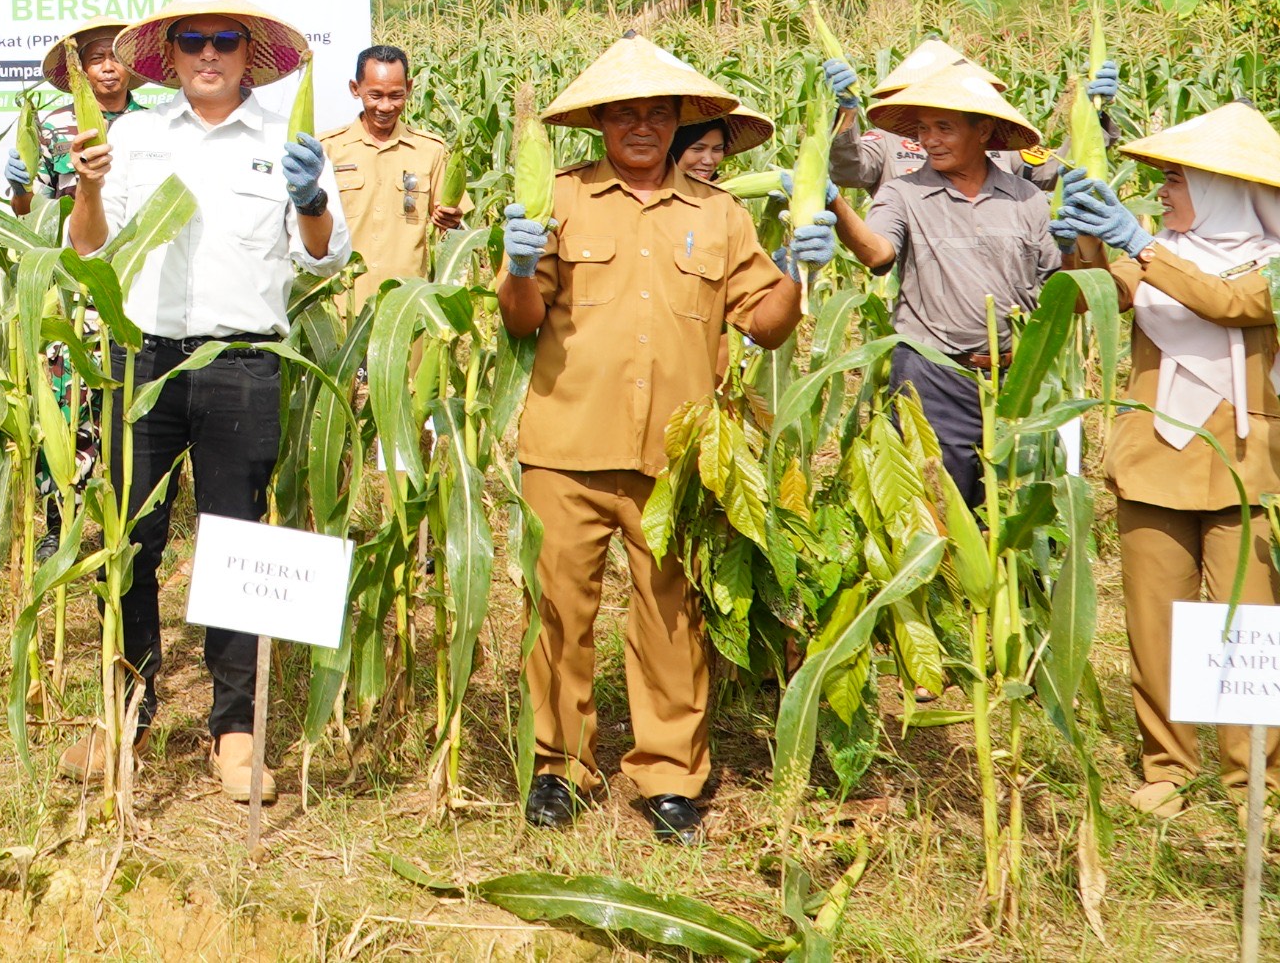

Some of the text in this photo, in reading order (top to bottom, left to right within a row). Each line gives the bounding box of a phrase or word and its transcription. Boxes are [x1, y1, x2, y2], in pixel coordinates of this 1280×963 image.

[226, 555, 317, 584] PT BERAU
[242, 581, 294, 603] COAL
[1219, 629, 1280, 646] KEPA
